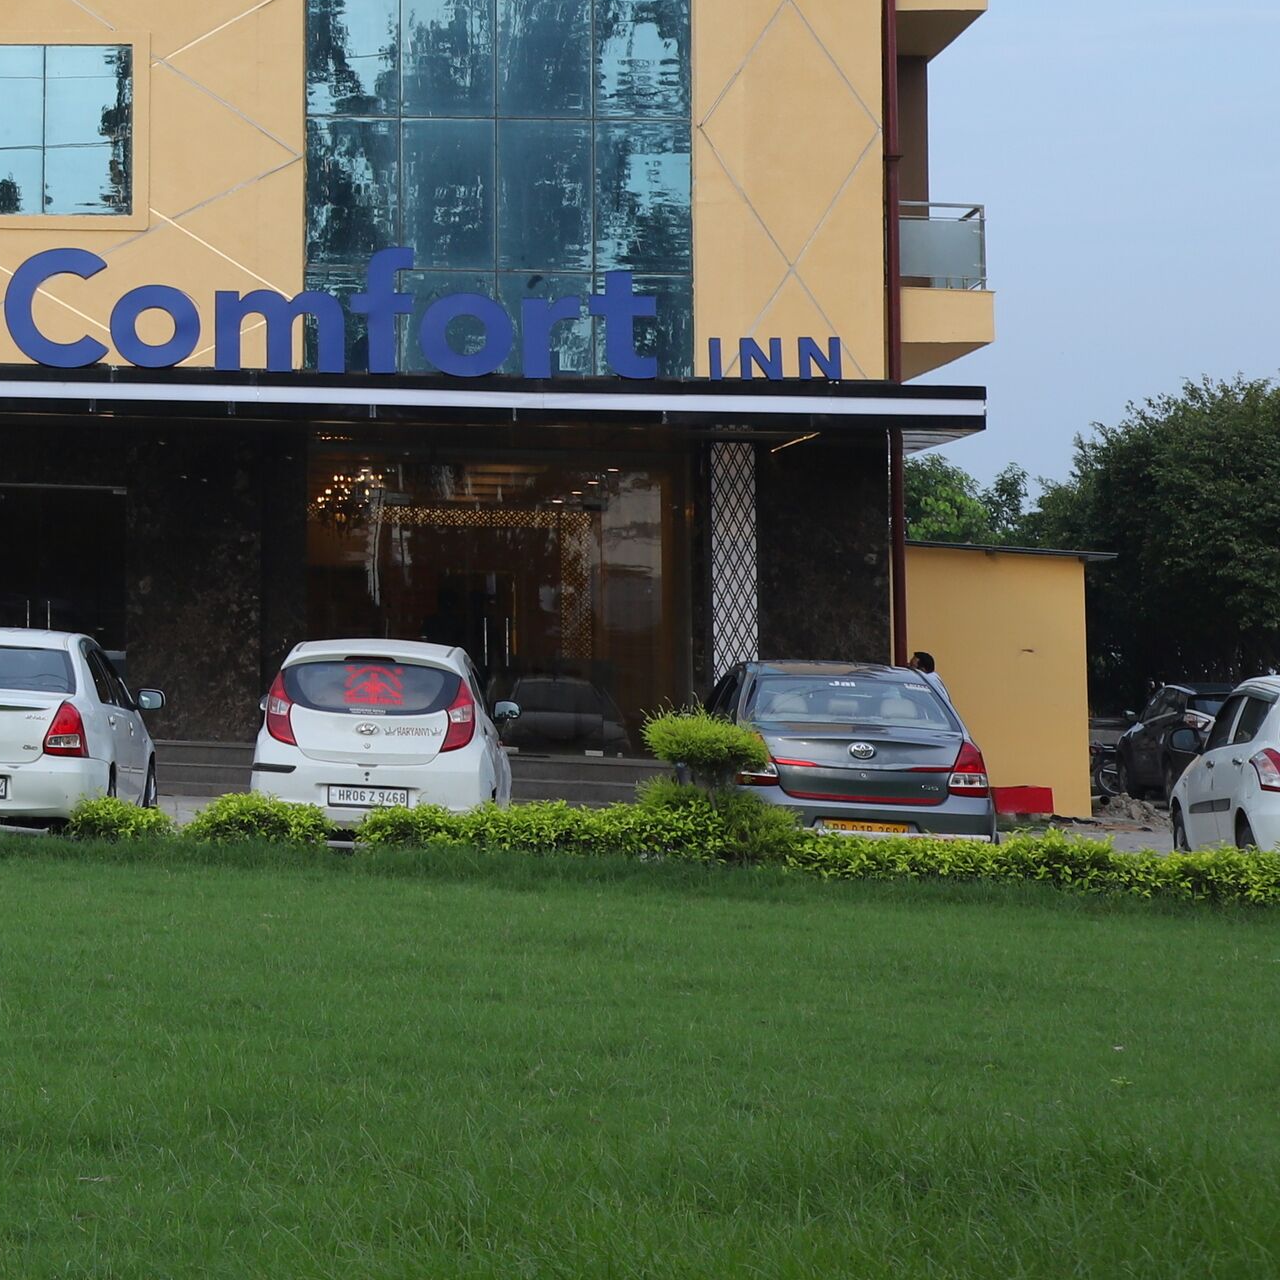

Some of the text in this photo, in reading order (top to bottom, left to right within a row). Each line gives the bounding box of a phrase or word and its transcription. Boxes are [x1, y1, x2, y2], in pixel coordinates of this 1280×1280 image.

[4, 247, 841, 381] Comfort INN
[338, 789, 405, 803] HR06 Z 9468
